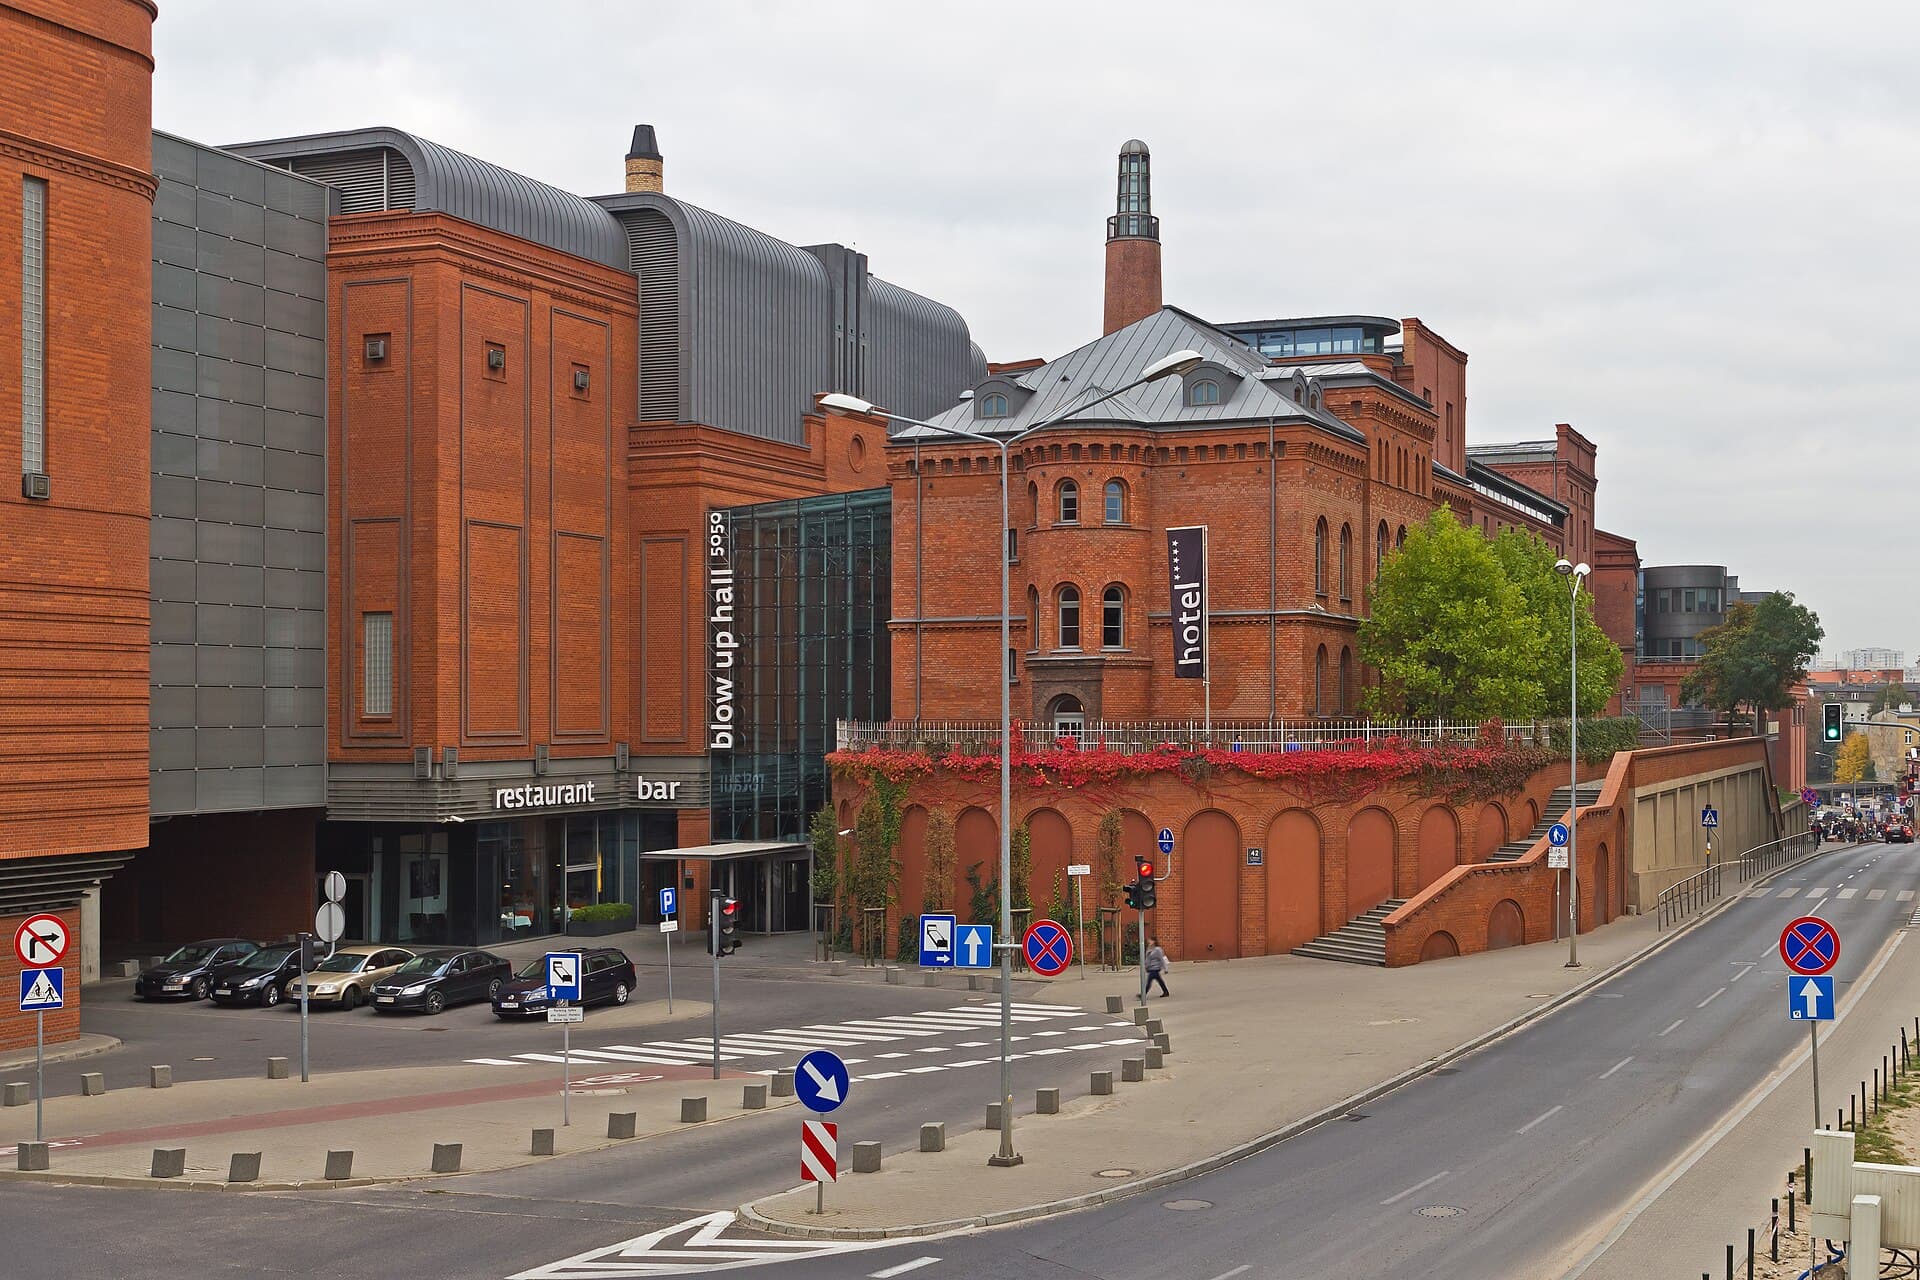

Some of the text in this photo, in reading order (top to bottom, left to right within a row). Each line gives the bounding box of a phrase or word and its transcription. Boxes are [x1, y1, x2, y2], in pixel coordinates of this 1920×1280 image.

[710, 568, 734, 623] hall
[1174, 583, 1201, 665] hotel
[715, 630, 740, 668] up
[710, 676, 734, 750] blow
[495, 780, 596, 809] restaurant
[636, 775, 682, 801] bar
[663, 891, 673, 912] P
